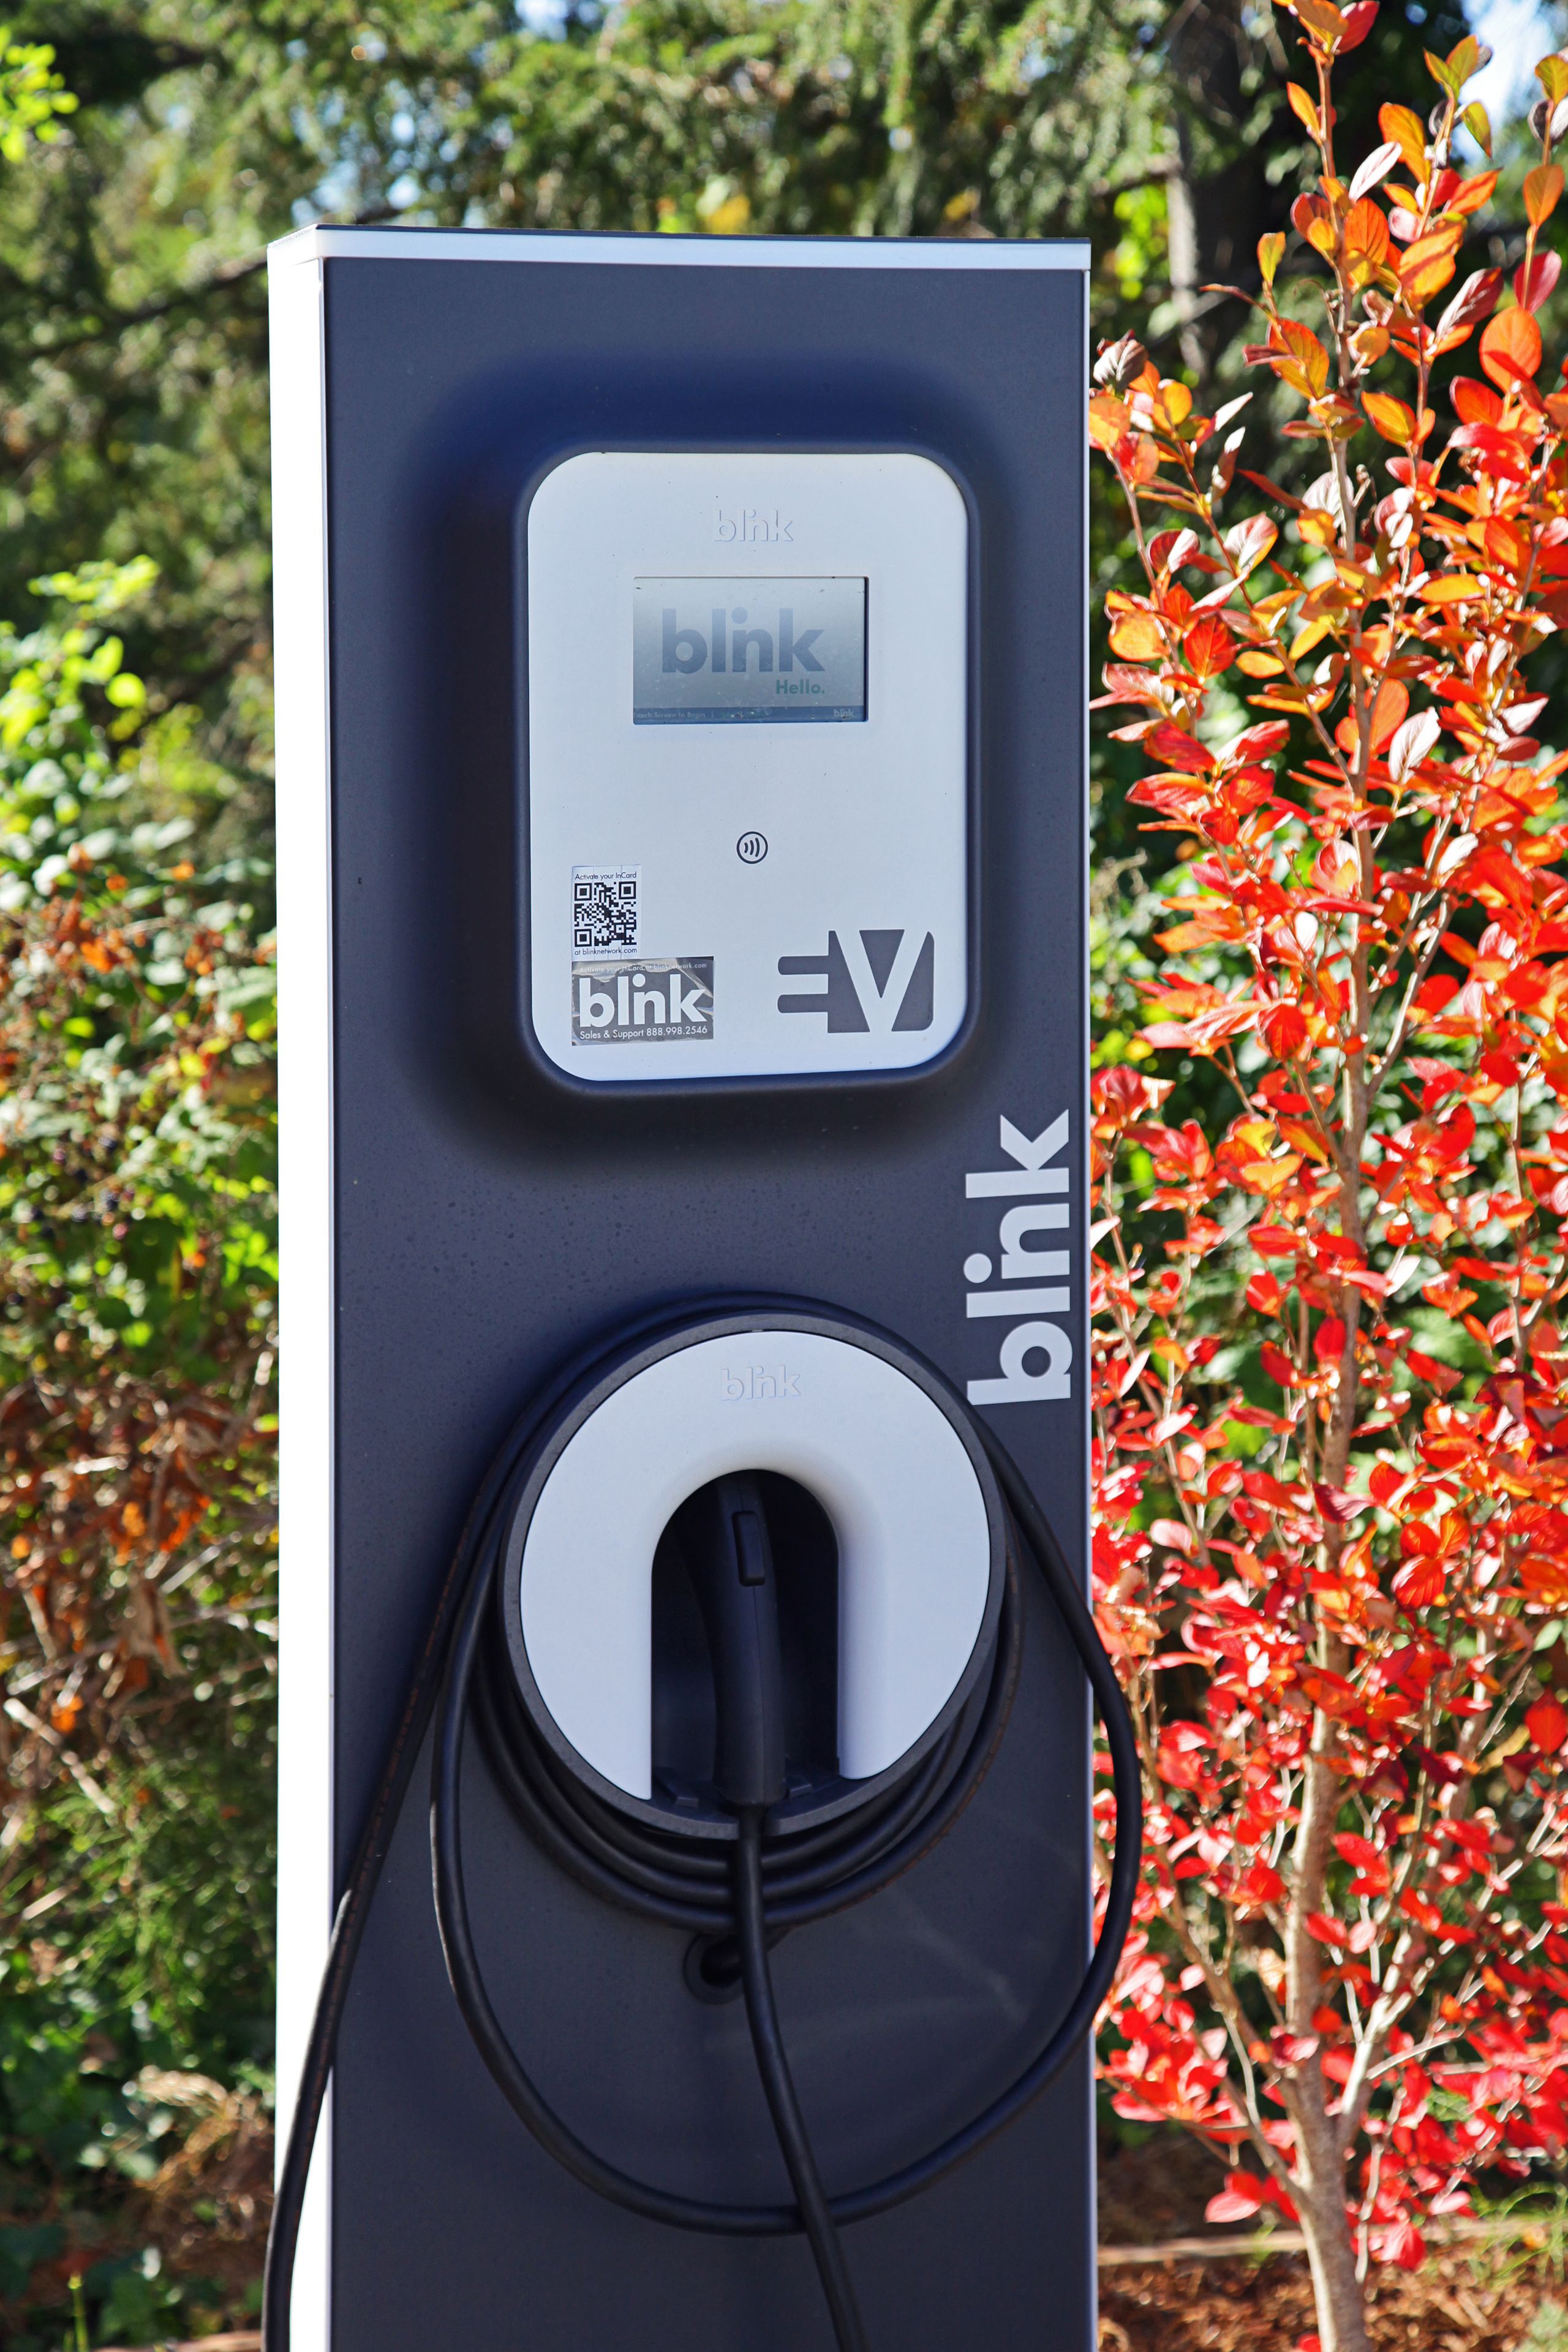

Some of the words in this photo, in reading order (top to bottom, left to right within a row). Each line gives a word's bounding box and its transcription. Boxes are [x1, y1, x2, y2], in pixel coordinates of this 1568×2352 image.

[713, 509, 794, 542] blink
[662, 607, 826, 674] blink
[775, 679, 825, 695] Hello.
[687, 710, 706, 719] Begin
[833, 708, 854, 717] blink
[579, 973, 707, 1028] blink
[579, 1031, 601, 1039] Sales
[603, 1030, 611, 1039] &
[612, 1029, 644, 1041] Support
[646, 1025, 708, 1036] 888.998.2546
[963, 1109, 1073, 1406] blink
[721, 1365, 802, 1401] blink
